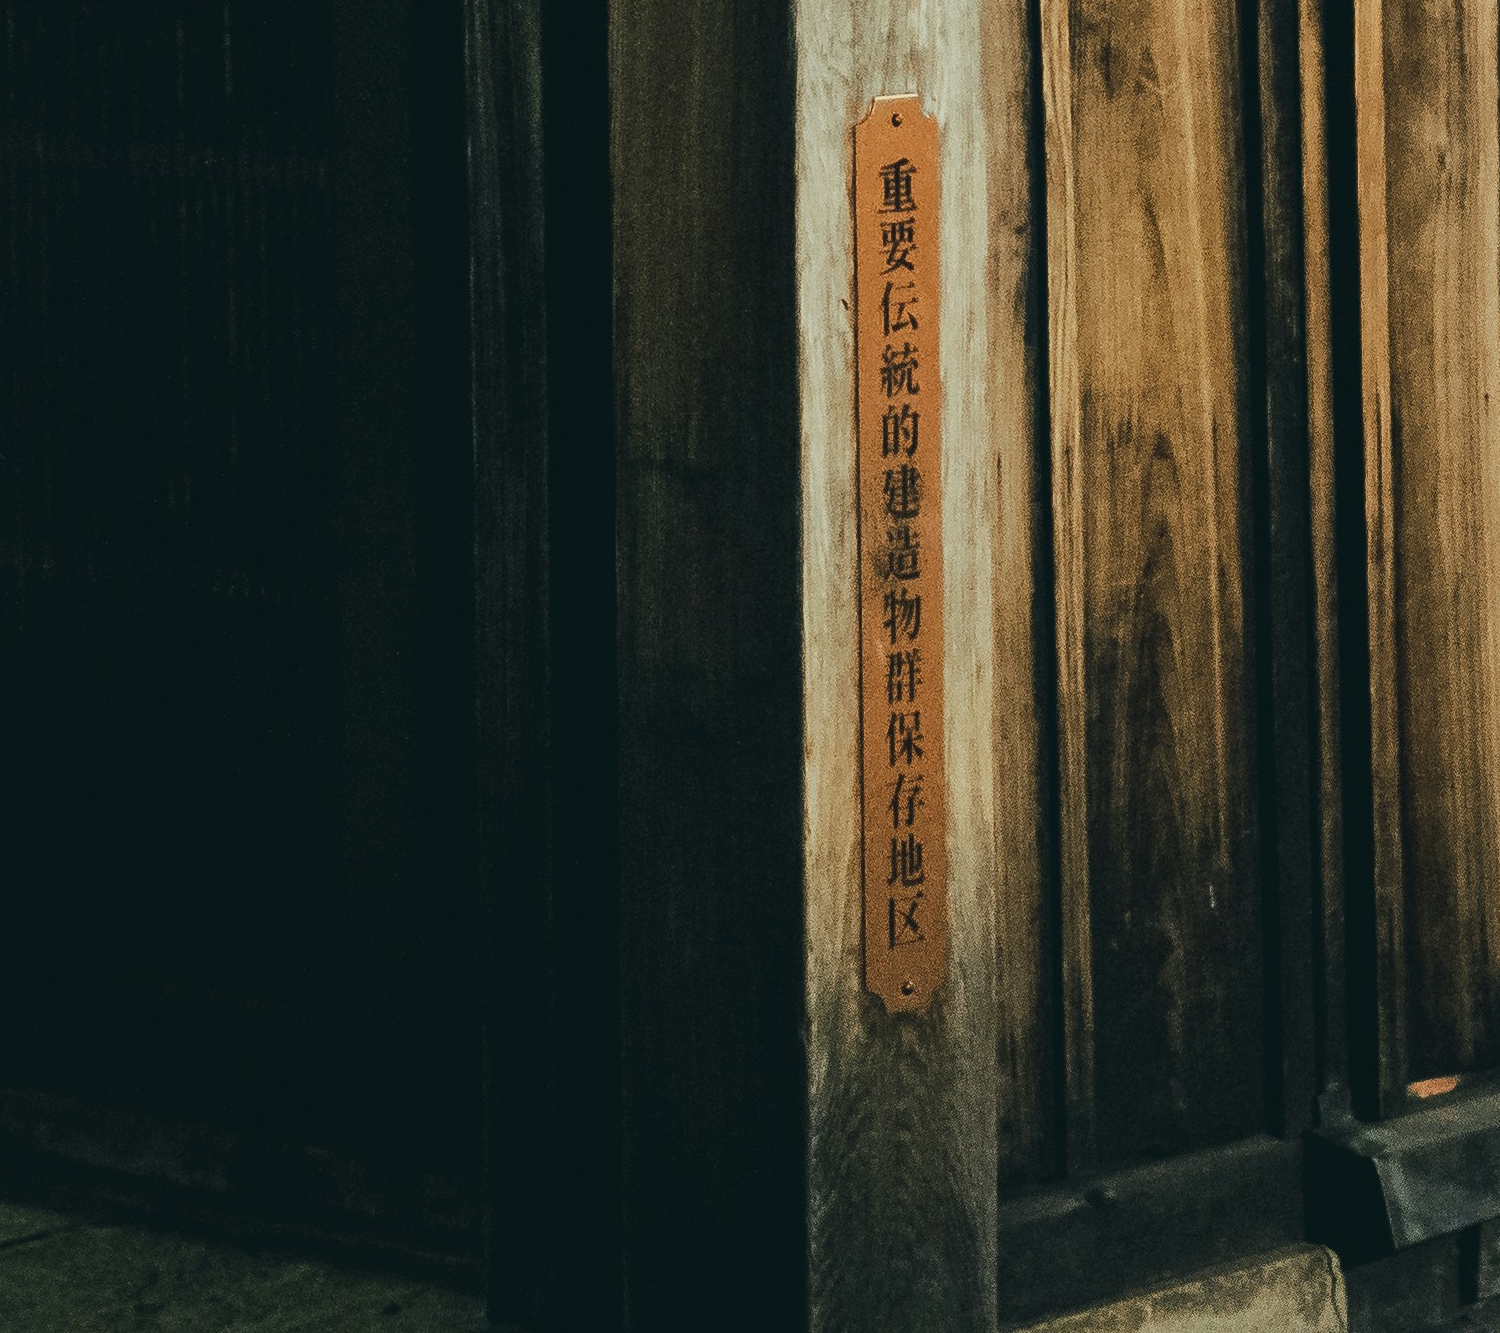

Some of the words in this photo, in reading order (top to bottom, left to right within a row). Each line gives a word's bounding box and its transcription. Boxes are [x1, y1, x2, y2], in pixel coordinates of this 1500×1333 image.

[876, 156, 925, 951] 重要伝統的建造物群保存地区
